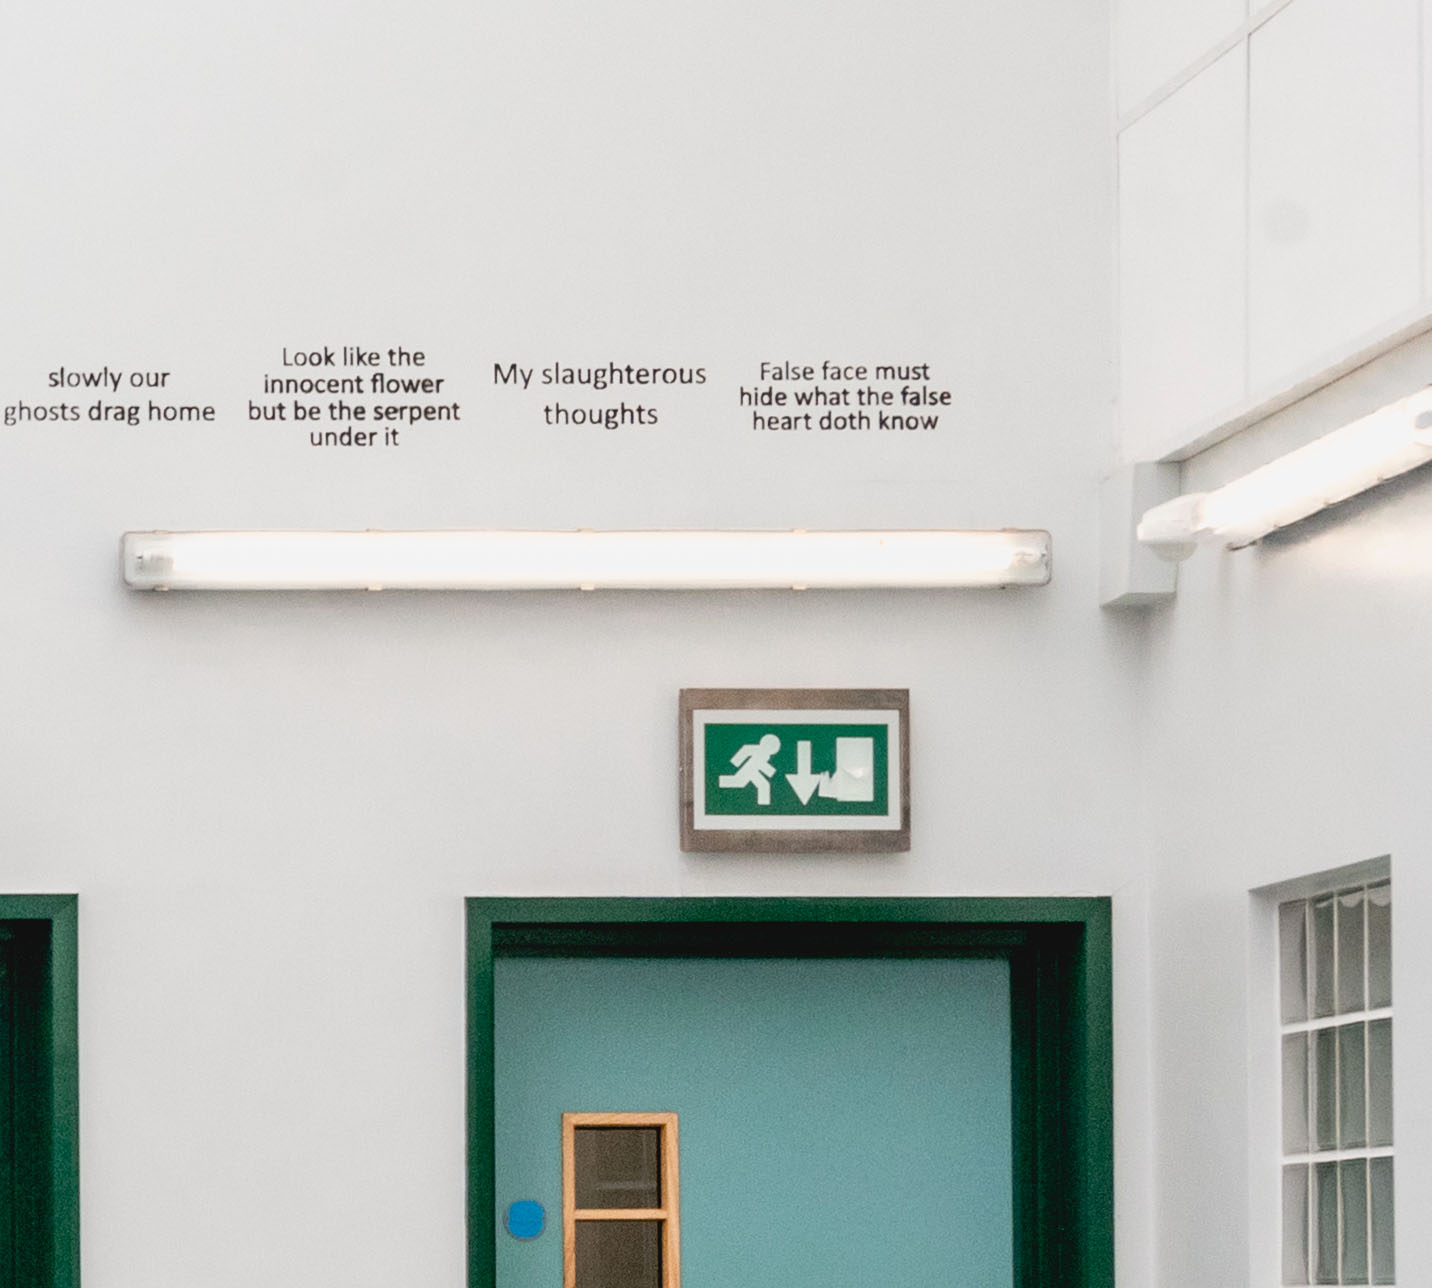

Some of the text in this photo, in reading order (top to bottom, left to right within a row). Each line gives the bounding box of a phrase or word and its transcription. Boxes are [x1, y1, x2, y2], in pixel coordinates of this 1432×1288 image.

[282, 345, 426, 367] Look like the
[48, 366, 171, 393] slowly our
[493, 361, 707, 391] My slaughterous
[760, 360, 931, 381] False face must
[264, 372, 445, 395] innocent flower
[739, 385, 952, 407] hide what the false
[4, 399, 216, 426] ghosts drag home
[248, 399, 461, 428] but be the serpent
[543, 401, 658, 430] thoughts
[752, 409, 939, 431] heart doth know
[310, 425, 399, 447] under it
